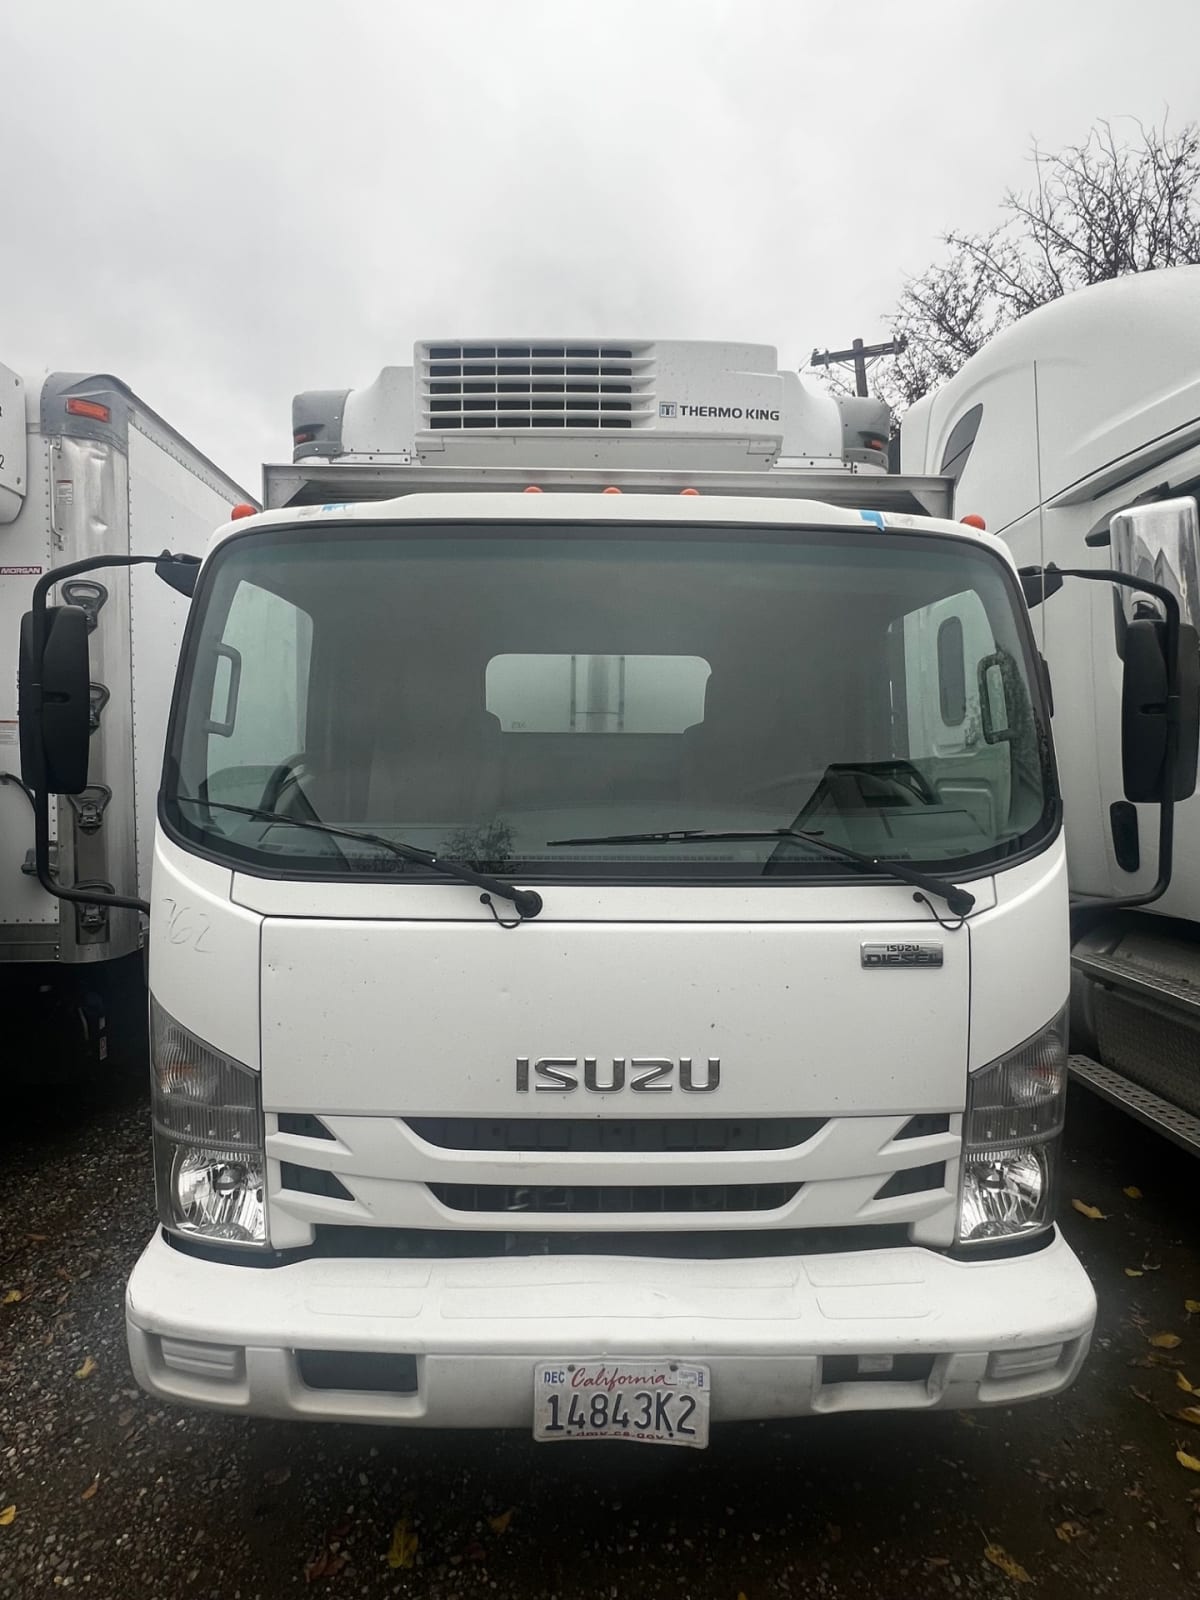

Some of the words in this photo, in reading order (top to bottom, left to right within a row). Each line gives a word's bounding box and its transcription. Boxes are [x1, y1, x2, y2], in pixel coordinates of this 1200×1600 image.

[680, 405, 743, 419] THERMO
[745, 408, 780, 421] KING
[866, 954, 940, 964] DIESEL
[516, 1057, 720, 1093] ISUZU
[544, 1371, 565, 1384] DEC
[571, 1367, 677, 1392] California
[545, 1392, 696, 1435] 14843K2
